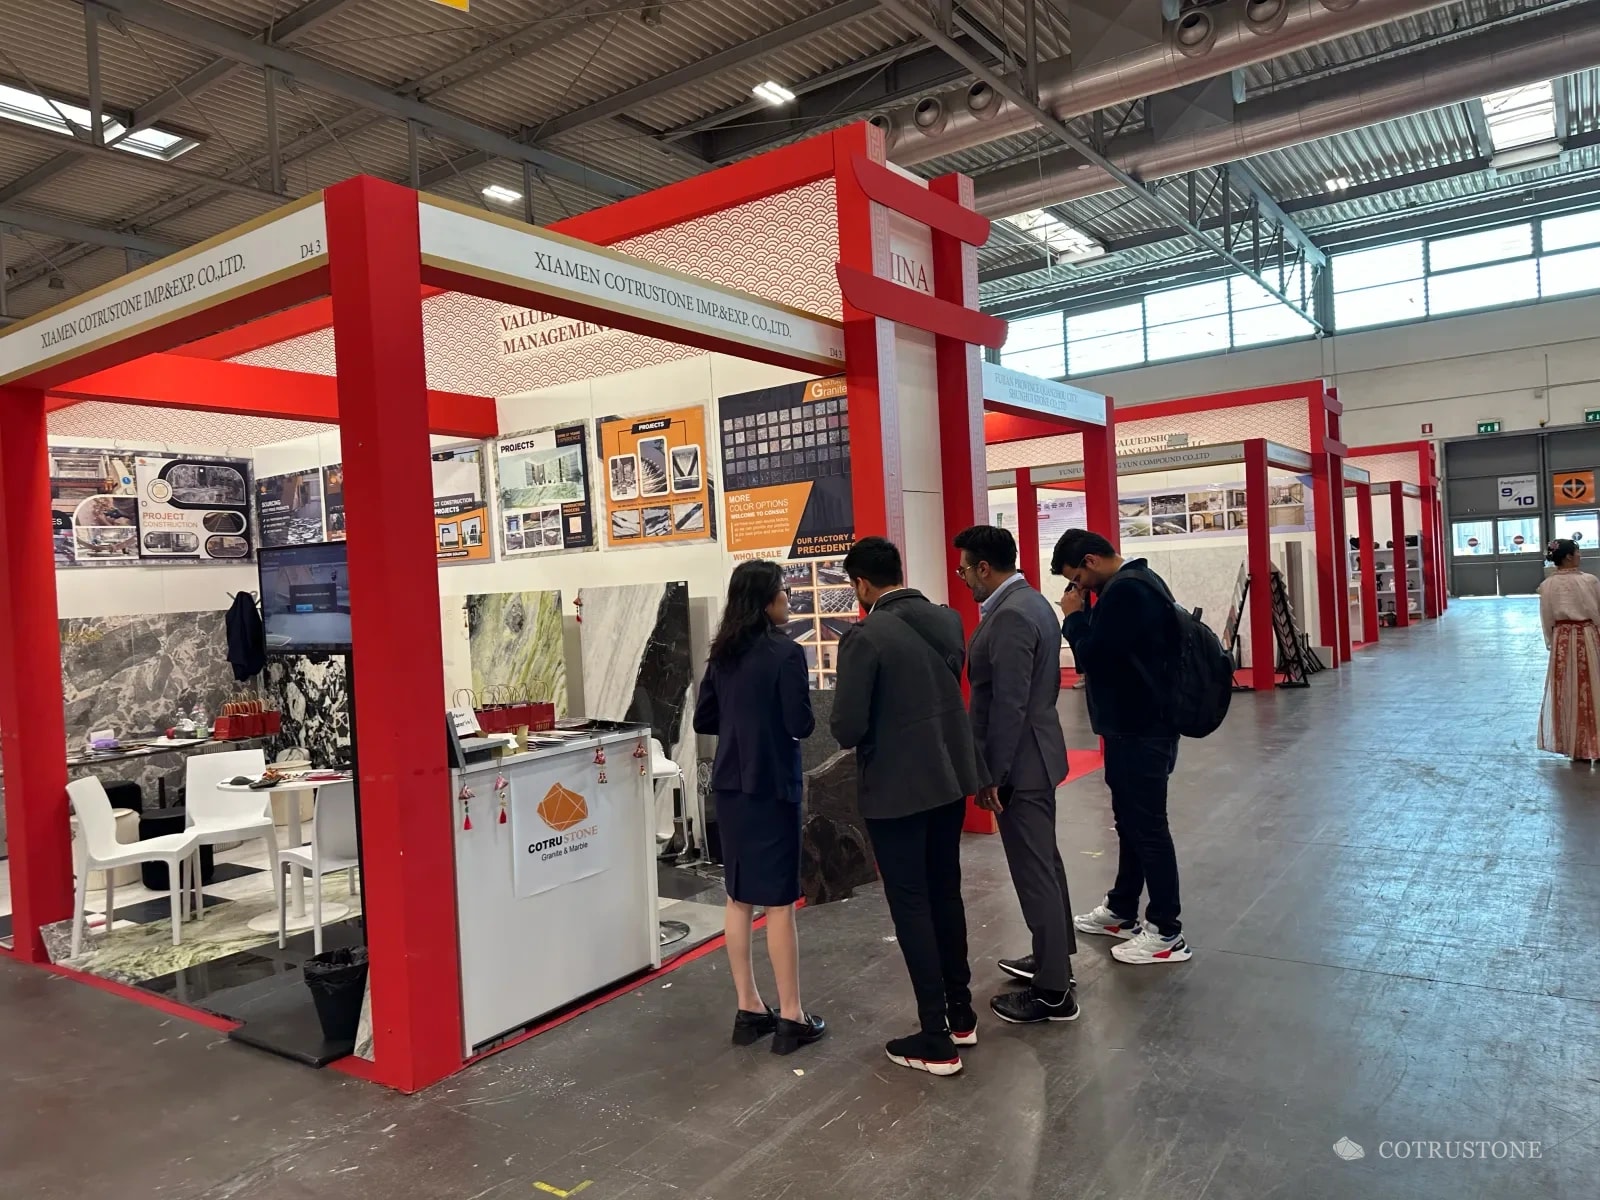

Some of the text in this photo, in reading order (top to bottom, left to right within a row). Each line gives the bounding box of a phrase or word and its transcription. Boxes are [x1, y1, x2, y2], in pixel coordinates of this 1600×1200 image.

[534, 251, 600, 285] XIAMEN
[604, 272, 694, 311] COTRUSTONE
[41, 321, 77, 348] XIAMEN
[79, 295, 142, 334] COTRUSTONE
[503, 321, 612, 355] MANAGEMEN
[638, 421, 665, 430] PROJECTS
[500, 440, 534, 453] PROJECTS
[1059, 468, 1081, 476] YUNFU
[1139, 455, 1181, 466] COMPOUND
[441, 497, 472, 506] CONSTRUCTION
[729, 494, 750, 503] MORE
[434, 506, 460, 515] PROJECTS
[729, 498, 789, 513] COLOR OPTIONS
[142, 512, 184, 521] PROJECT
[730, 511, 755, 519] WELCOME
[764, 508, 788, 516] CONSULT
[143, 521, 198, 529] CONSTRUCTION
[797, 537, 812, 545] OUR
[814, 533, 849, 543] FACTORY
[733, 551, 781, 560] WHOLESALE
[541, 841, 589, 861] Granite & Marble
